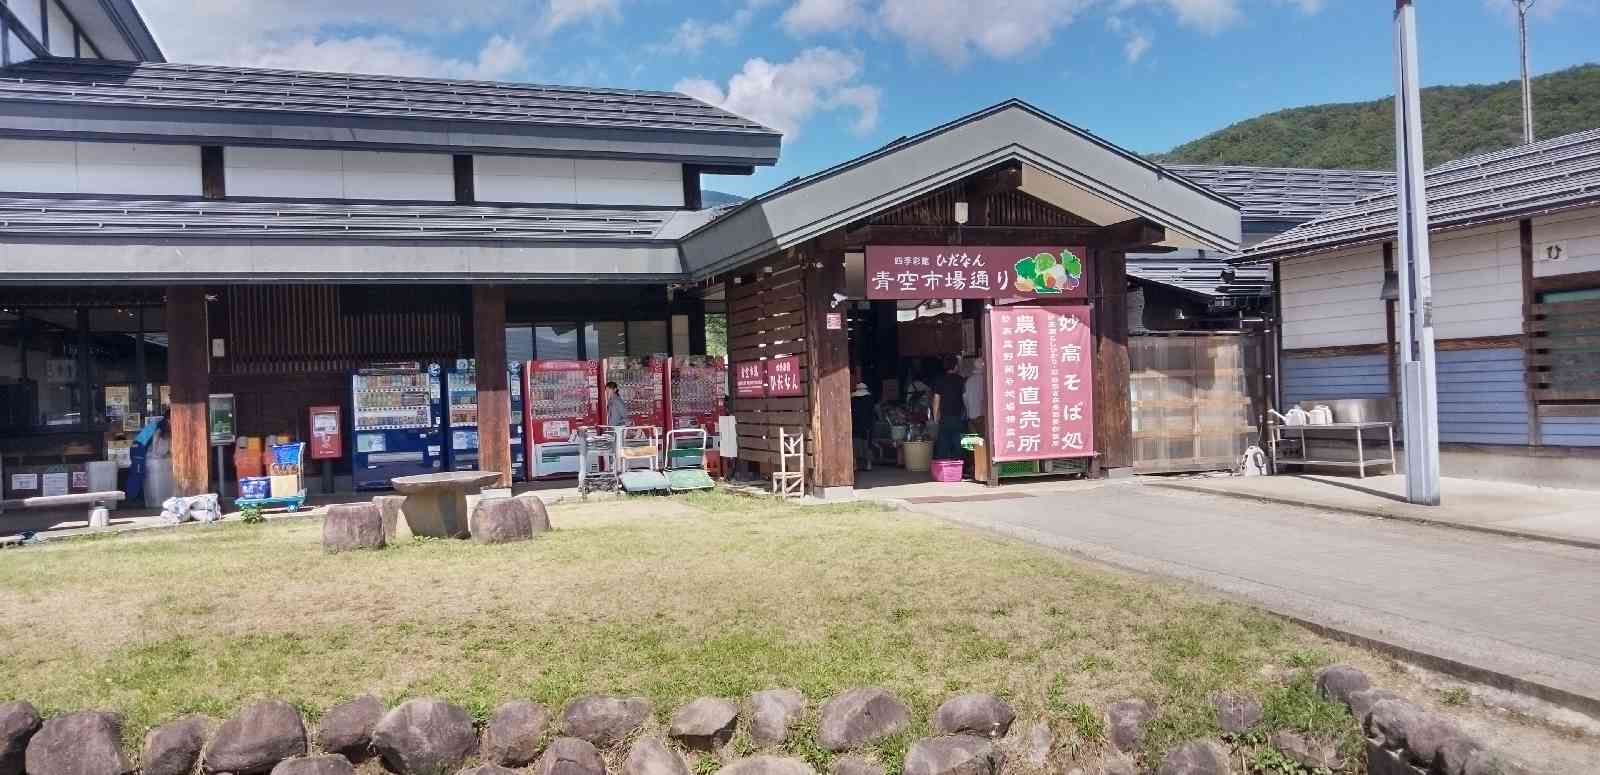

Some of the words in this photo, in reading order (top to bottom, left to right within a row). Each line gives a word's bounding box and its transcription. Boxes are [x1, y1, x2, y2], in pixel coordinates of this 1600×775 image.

[936, 252, 985, 268] ひだなん
[872, 270, 1009, 292] 青空市場通り
[770, 374, 799, 391] ひだなん
[1014, 315, 1042, 453] 農産物直売所
[1058, 314, 1084, 450] 妙高そば処
